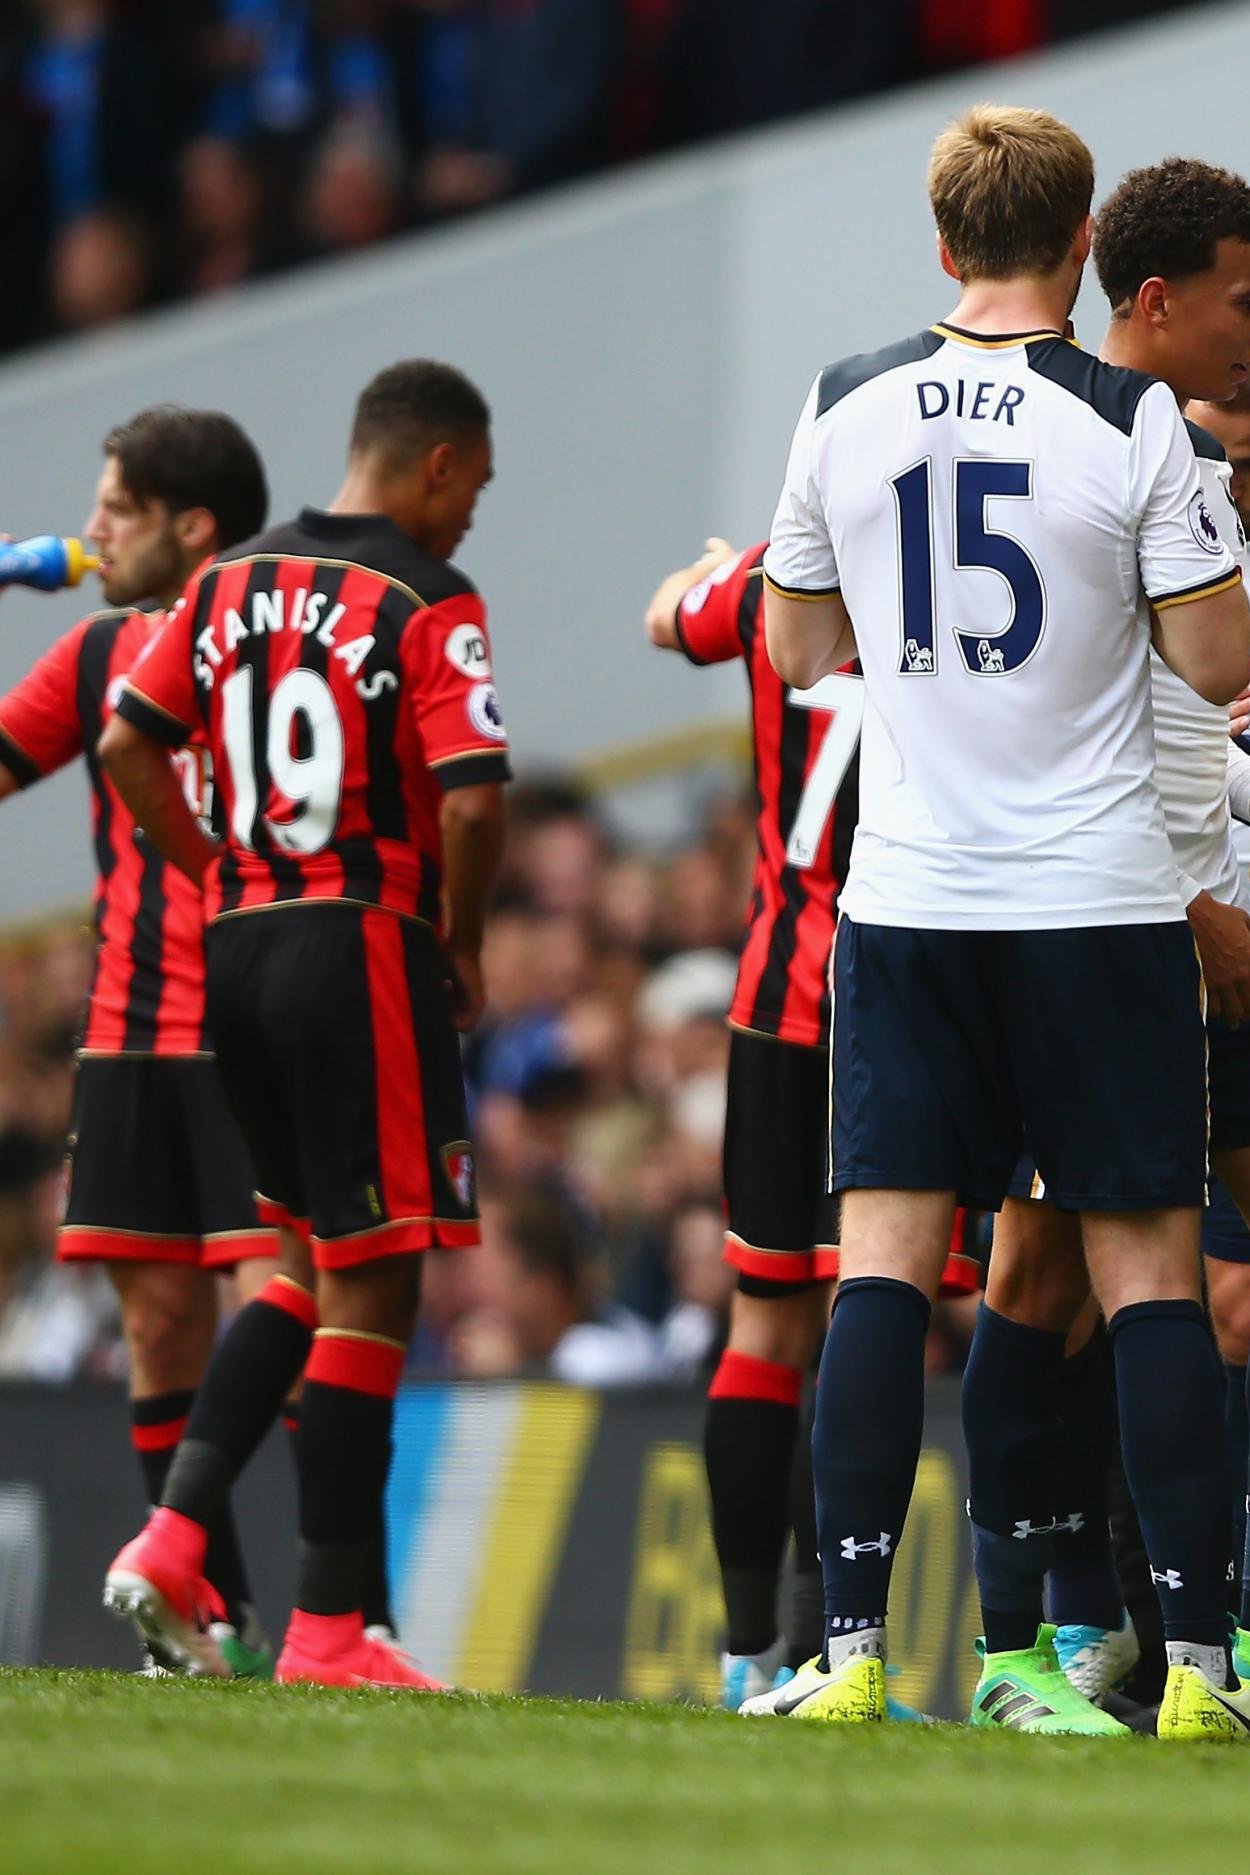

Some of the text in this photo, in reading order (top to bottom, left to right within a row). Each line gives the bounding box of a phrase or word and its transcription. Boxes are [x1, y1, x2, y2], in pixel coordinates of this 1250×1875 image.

[917, 380, 1026, 426] DIER
[193, 587, 399, 691] STANISLAS
[887, 455, 1048, 677] 15
[463, 637, 487, 665] JD
[222, 665, 345, 855] 19
[786, 671, 866, 870] 7
